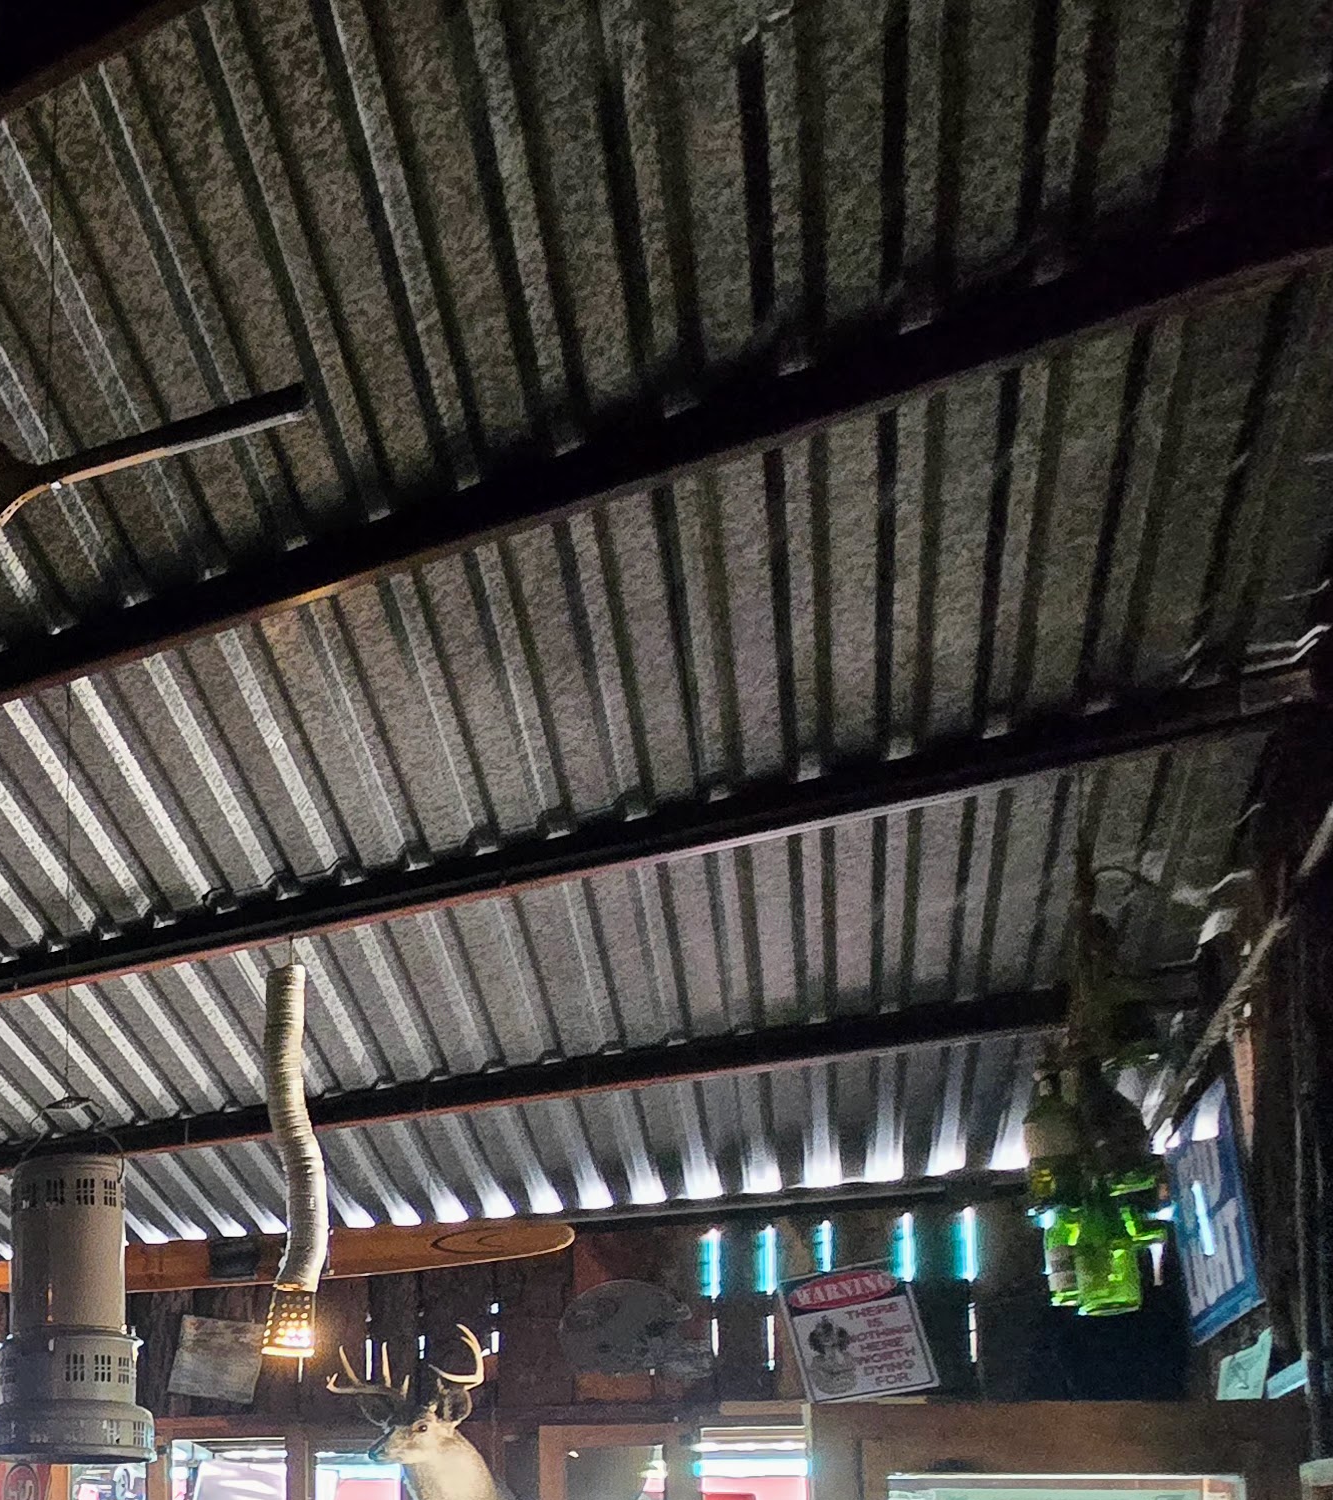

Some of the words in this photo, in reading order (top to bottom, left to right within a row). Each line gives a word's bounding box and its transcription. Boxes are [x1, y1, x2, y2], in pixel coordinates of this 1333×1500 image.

[796, 1274, 893, 1306] WARNING
[845, 1302, 899, 1321] THERE
[866, 1317, 883, 1329] IS
[848, 1324, 913, 1344] NOTHING
[859, 1336, 905, 1352] HERE
[854, 1347, 916, 1366] WORTH
[863, 1359, 915, 1377] DYING
